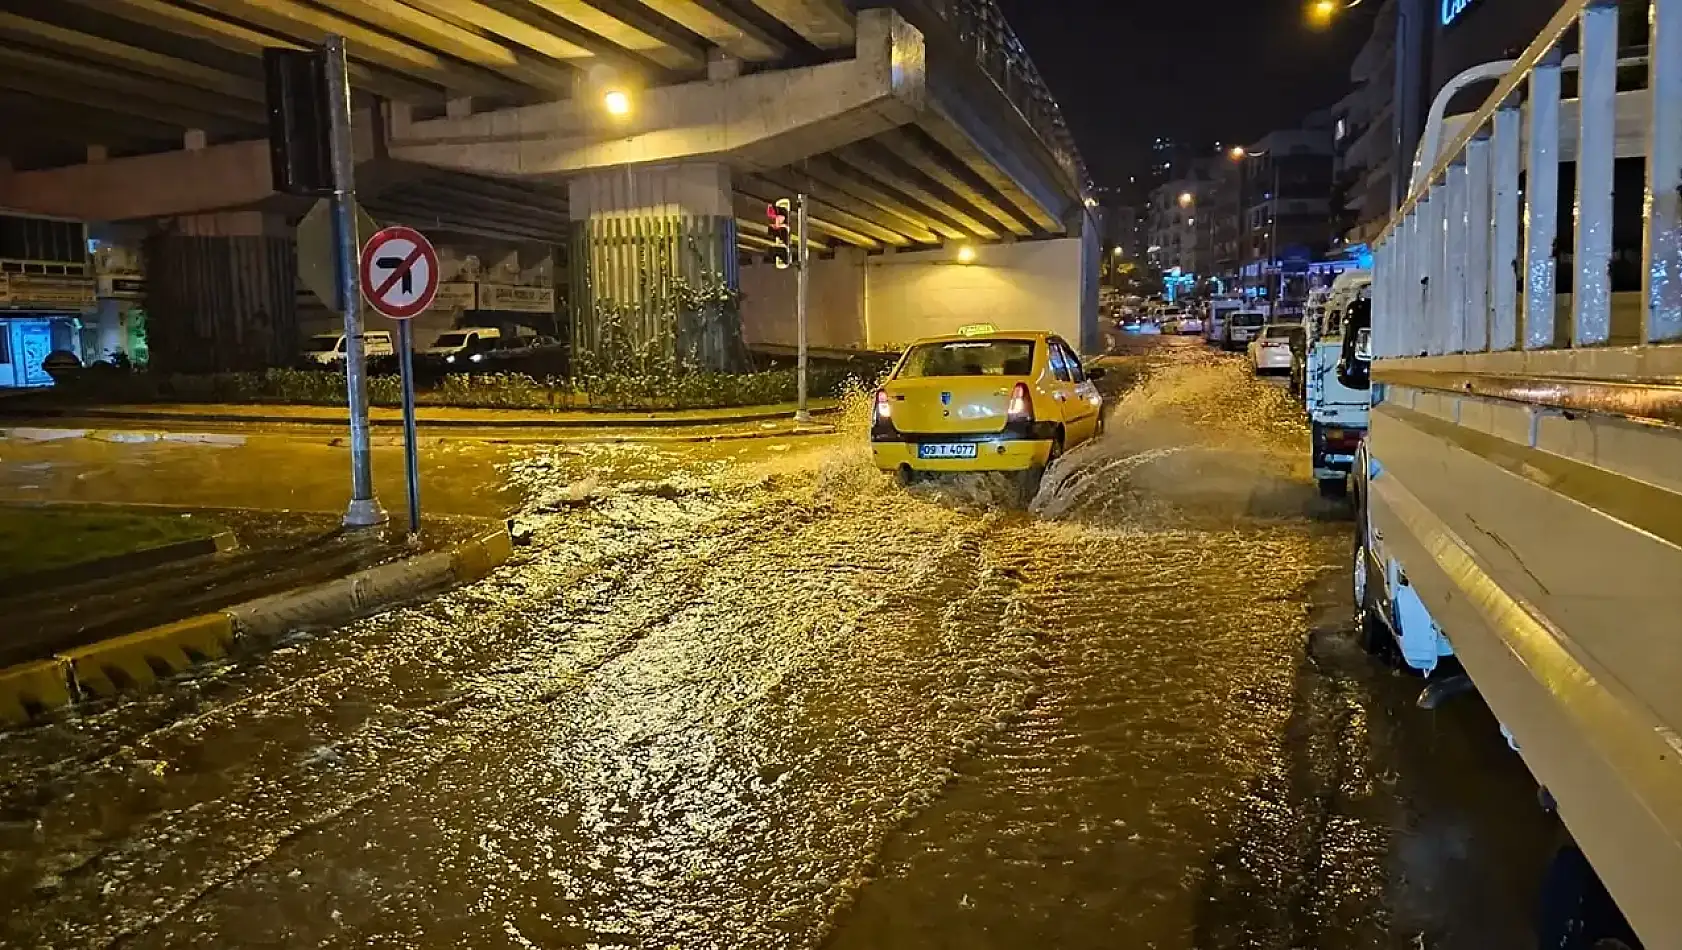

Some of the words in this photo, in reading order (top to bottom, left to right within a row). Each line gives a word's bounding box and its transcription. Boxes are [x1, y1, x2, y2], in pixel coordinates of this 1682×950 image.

[924, 445, 936, 455] 09
[940, 445, 947, 455] T
[950, 445, 975, 455] 4077
